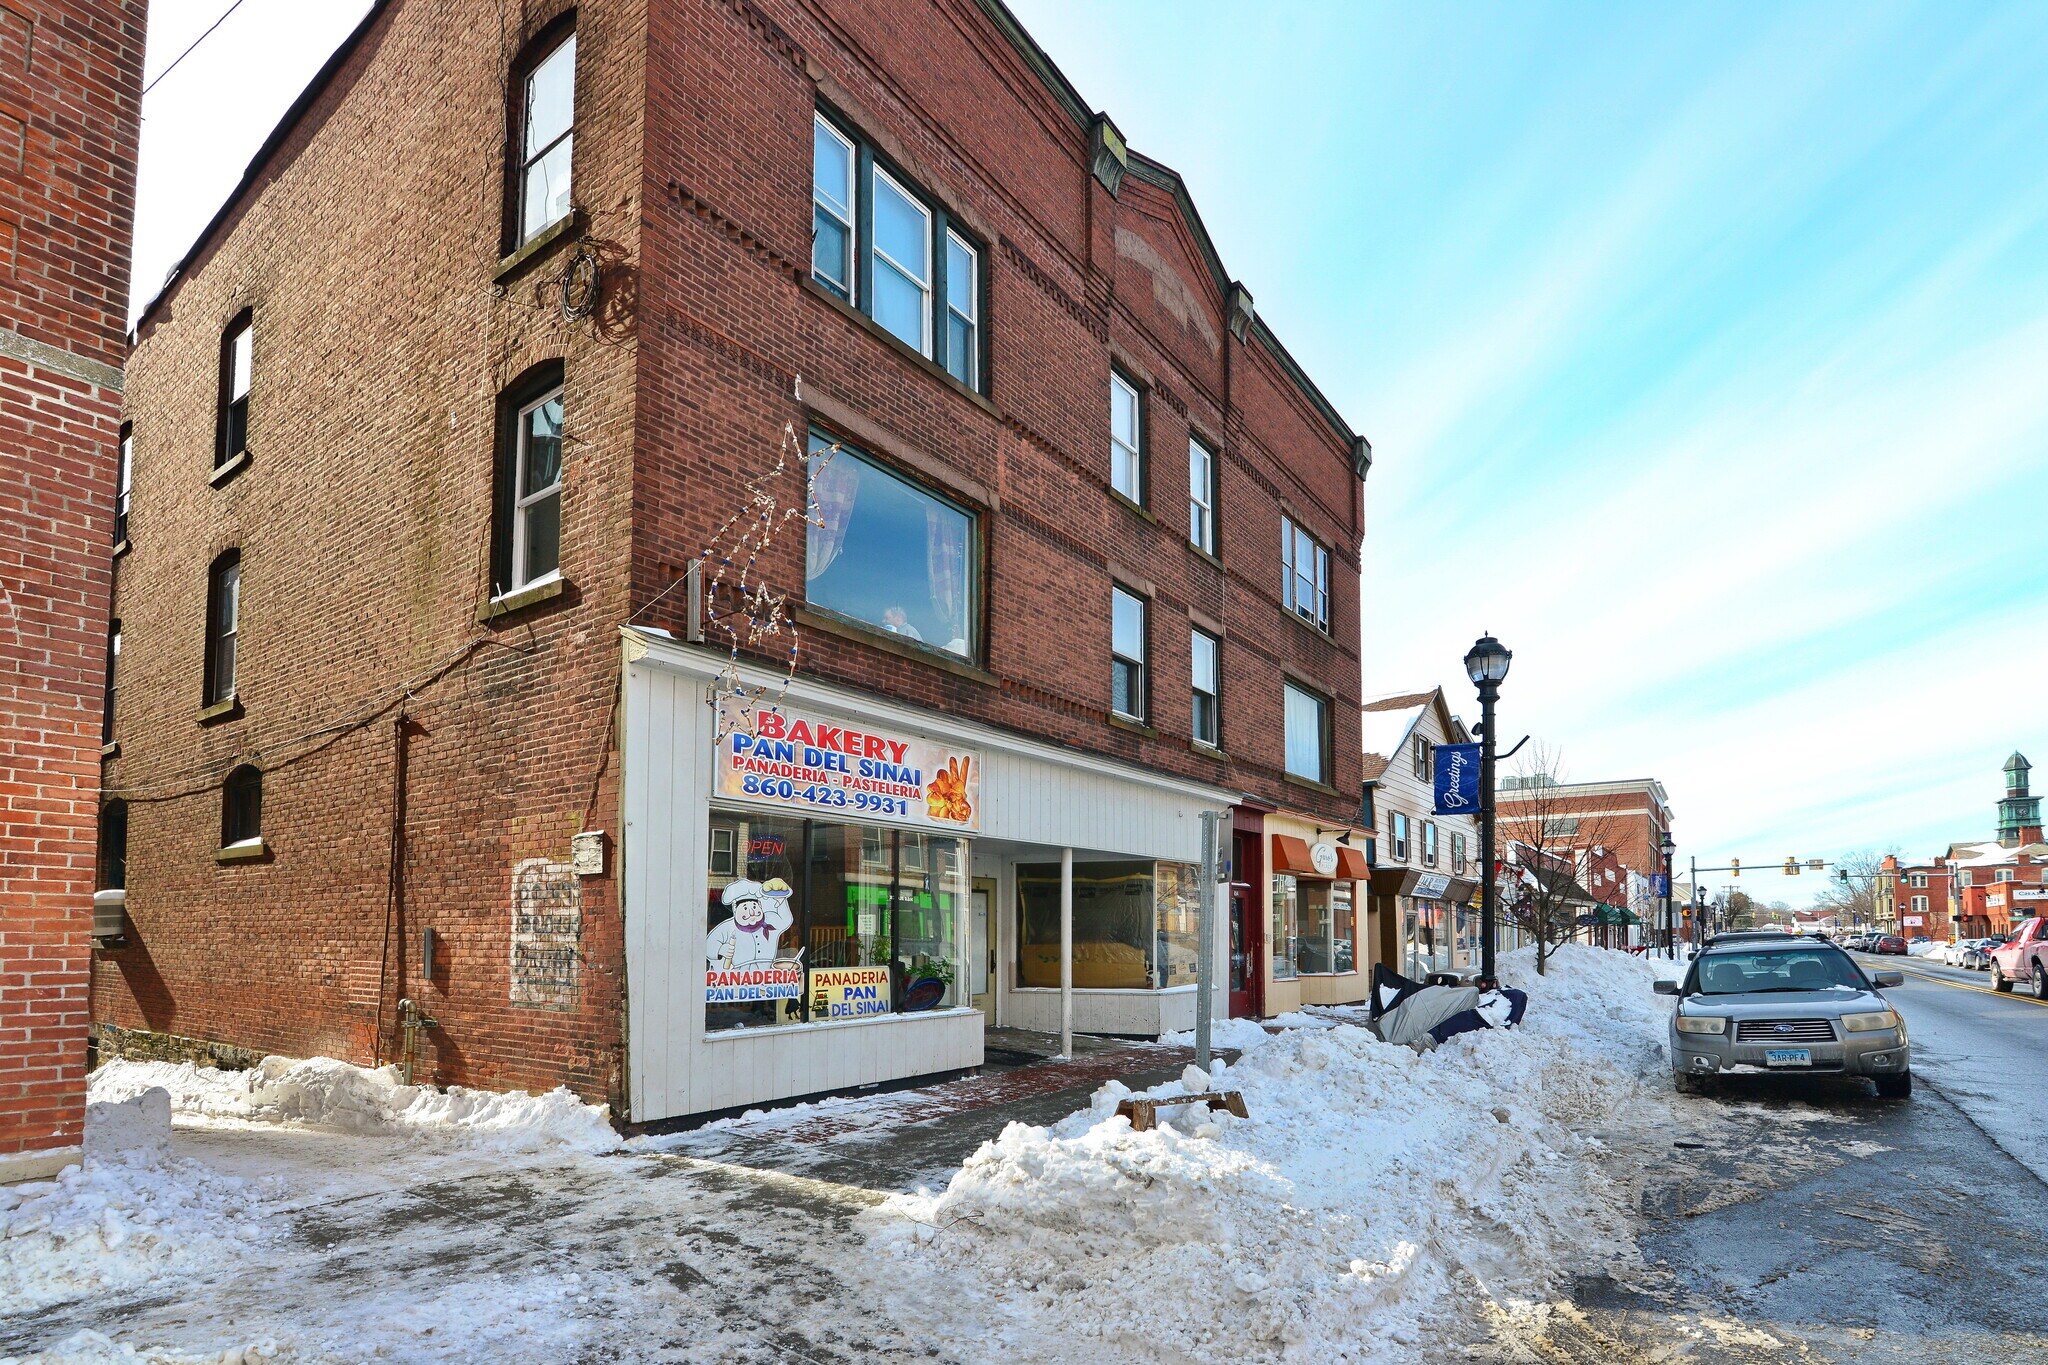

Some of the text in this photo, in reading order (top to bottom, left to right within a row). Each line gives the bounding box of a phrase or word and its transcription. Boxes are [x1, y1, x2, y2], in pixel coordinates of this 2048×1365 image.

[757, 710, 909, 764] BAKERY
[732, 733, 922, 786] PAN DEL SINAI
[732, 755, 828, 784] PANADERIA
[842, 776, 922, 800] PASTELERIA
[1444, 751, 1469, 808] Greetings
[742, 775, 908, 816] 860-423-9931
[741, 840, 785, 855] OPEN
[706, 969, 799, 987] PANADERIA
[815, 971, 888, 987] PANADERIA
[706, 985, 799, 1001] PAN DEL SINAI
[844, 986, 876, 1000] PAN
[831, 1000, 889, 1017] DEL SINAI
